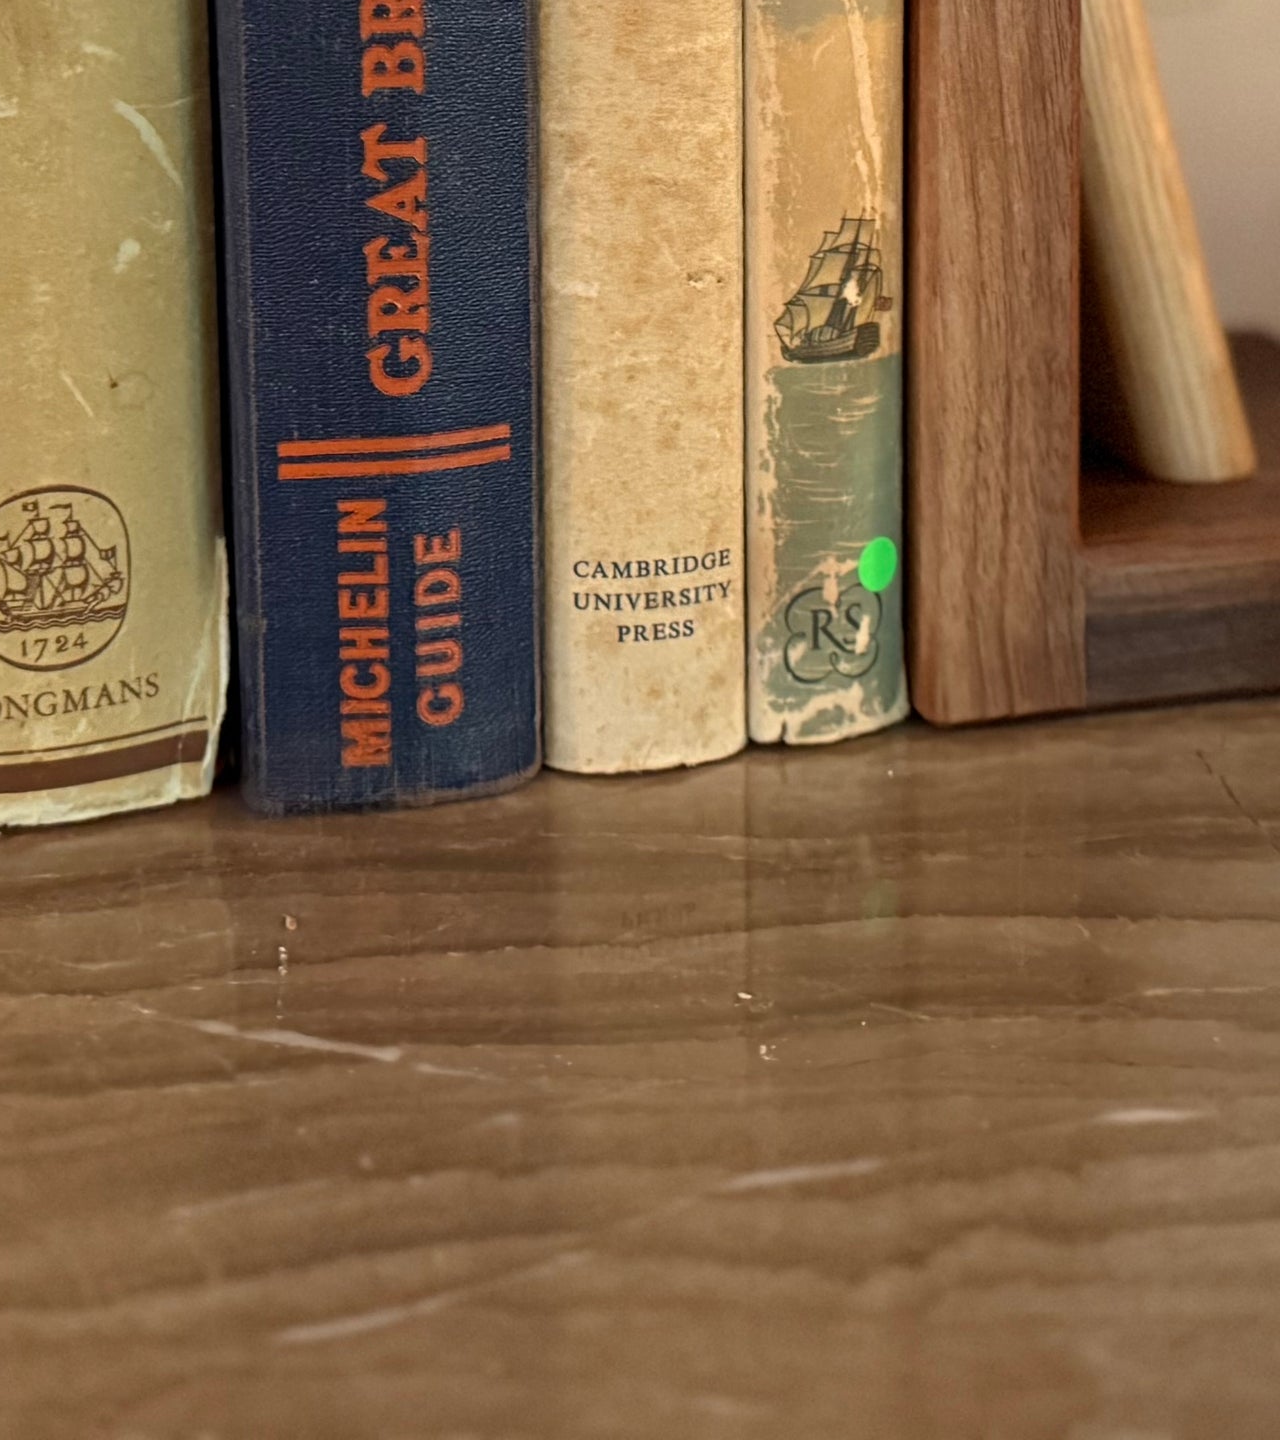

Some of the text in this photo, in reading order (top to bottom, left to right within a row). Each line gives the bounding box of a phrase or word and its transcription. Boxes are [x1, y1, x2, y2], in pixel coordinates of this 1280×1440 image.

[363, 122, 433, 397] GREAT
[572, 547, 732, 580] CAMBRIDGE
[572, 579, 733, 612] UNIVERSITY
[336, 498, 393, 768] MICHELIN
[413, 524, 465, 728] GUIDE
[616, 619, 696, 643] PRESS
[20, 631, 89, 663] 1724
